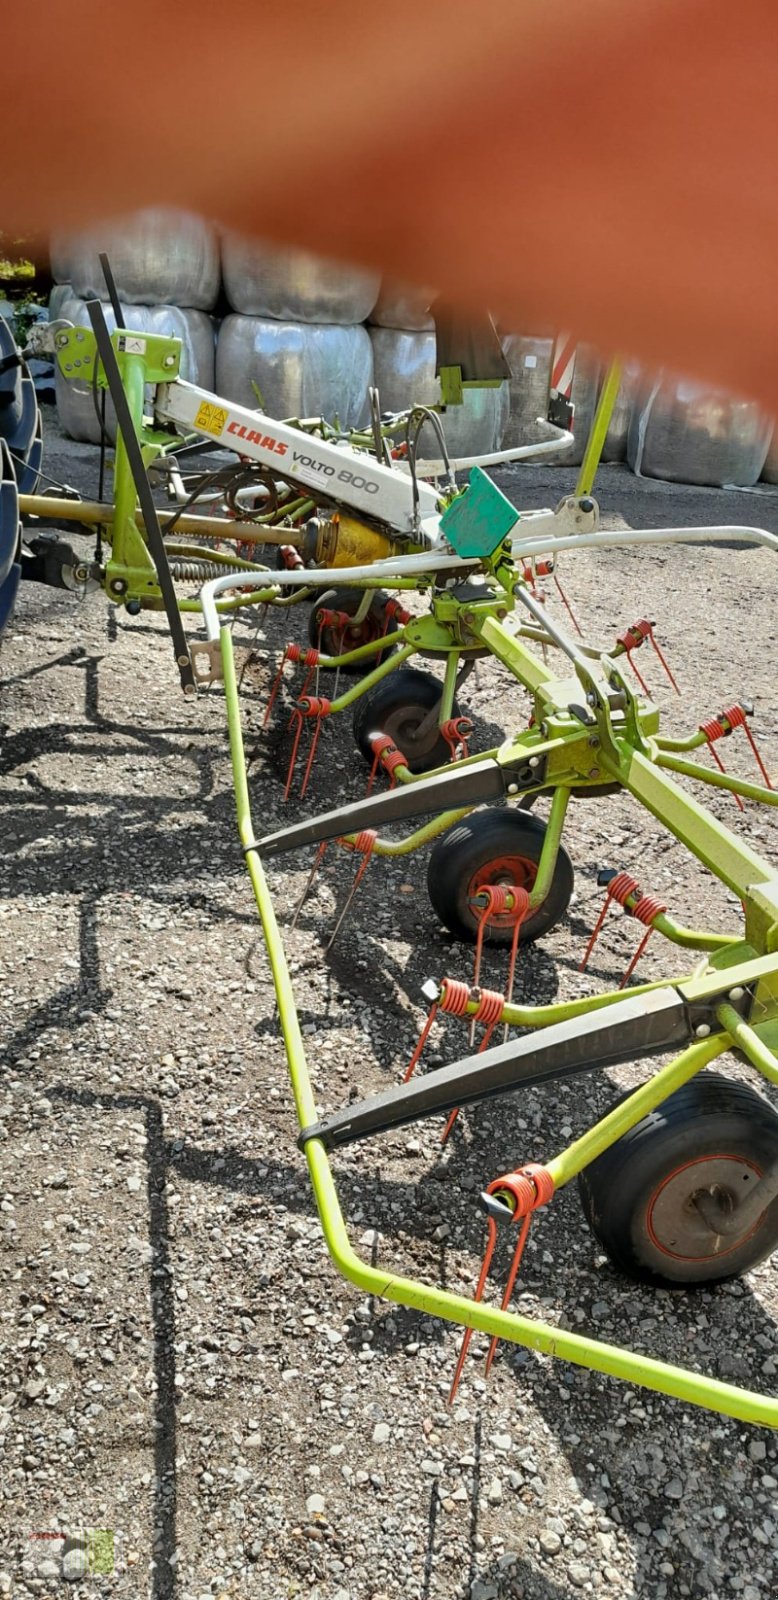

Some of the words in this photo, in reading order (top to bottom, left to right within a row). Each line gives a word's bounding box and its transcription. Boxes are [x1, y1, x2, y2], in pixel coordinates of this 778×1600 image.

[227, 422, 288, 456] CLAAS
[292, 451, 335, 476] VOLTO
[337, 470, 380, 494] 800
